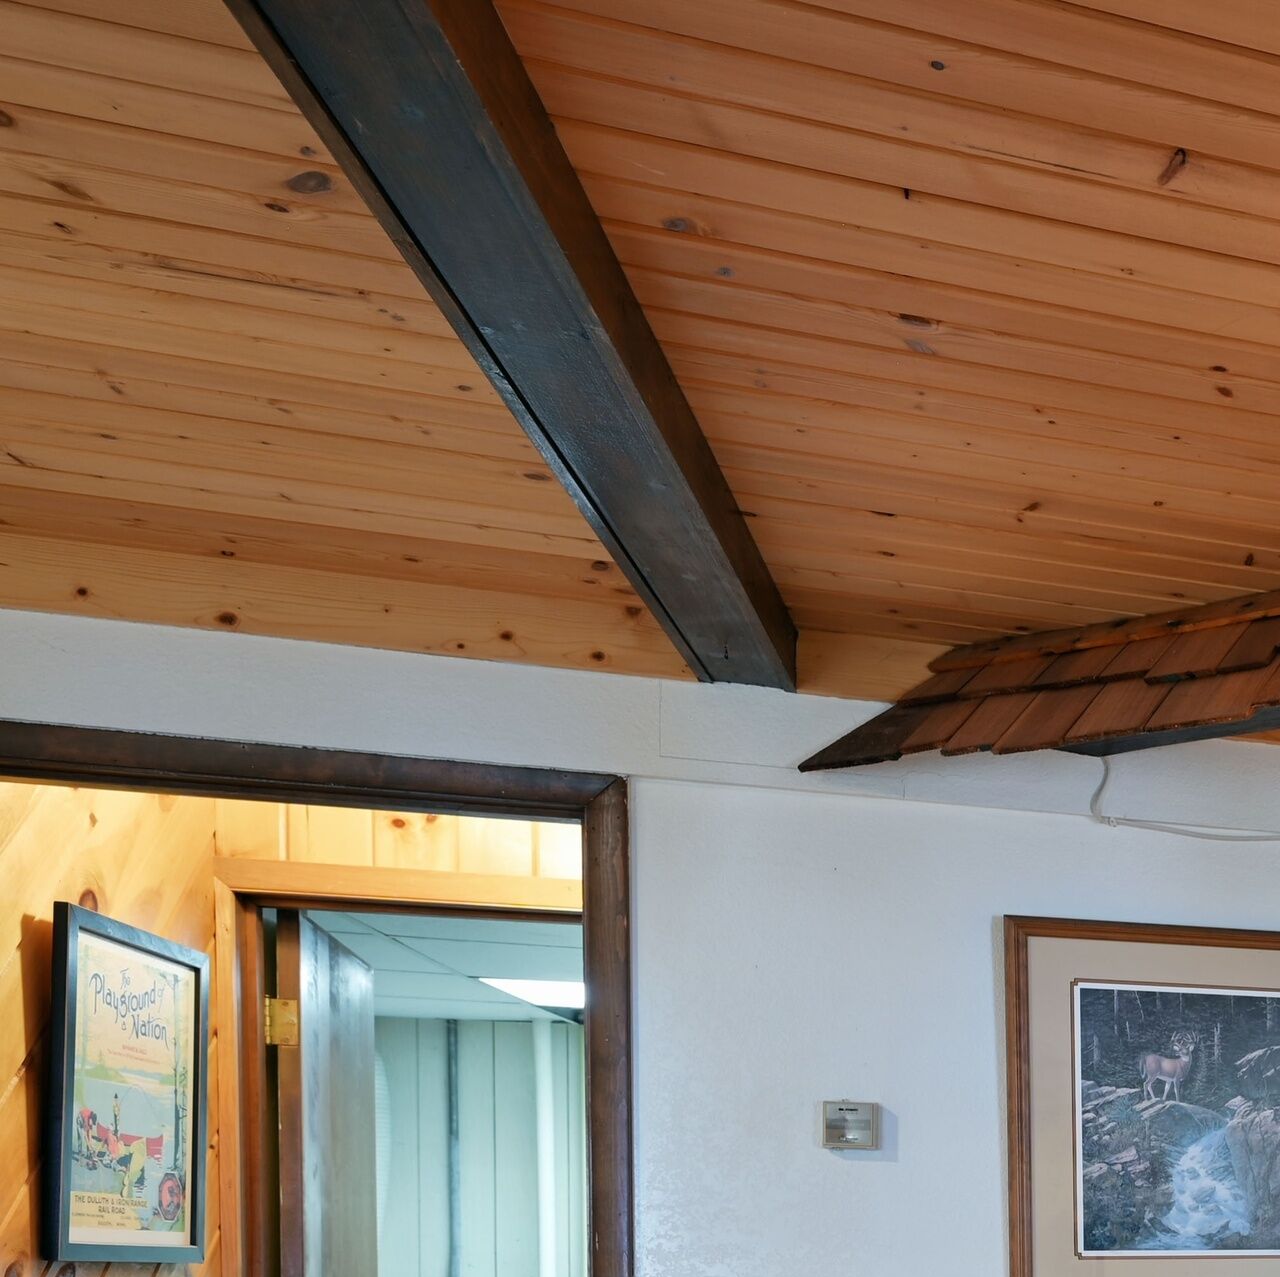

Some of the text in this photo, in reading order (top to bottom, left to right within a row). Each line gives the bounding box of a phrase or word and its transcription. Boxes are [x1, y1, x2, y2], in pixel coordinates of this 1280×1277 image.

[89, 972, 157, 1024] Playground
[129, 1012, 170, 1051] Nation
[74, 1194, 86, 1204] THE
[87, 1195, 109, 1205] DULUTH
[115, 1198, 130, 1207] IRON
